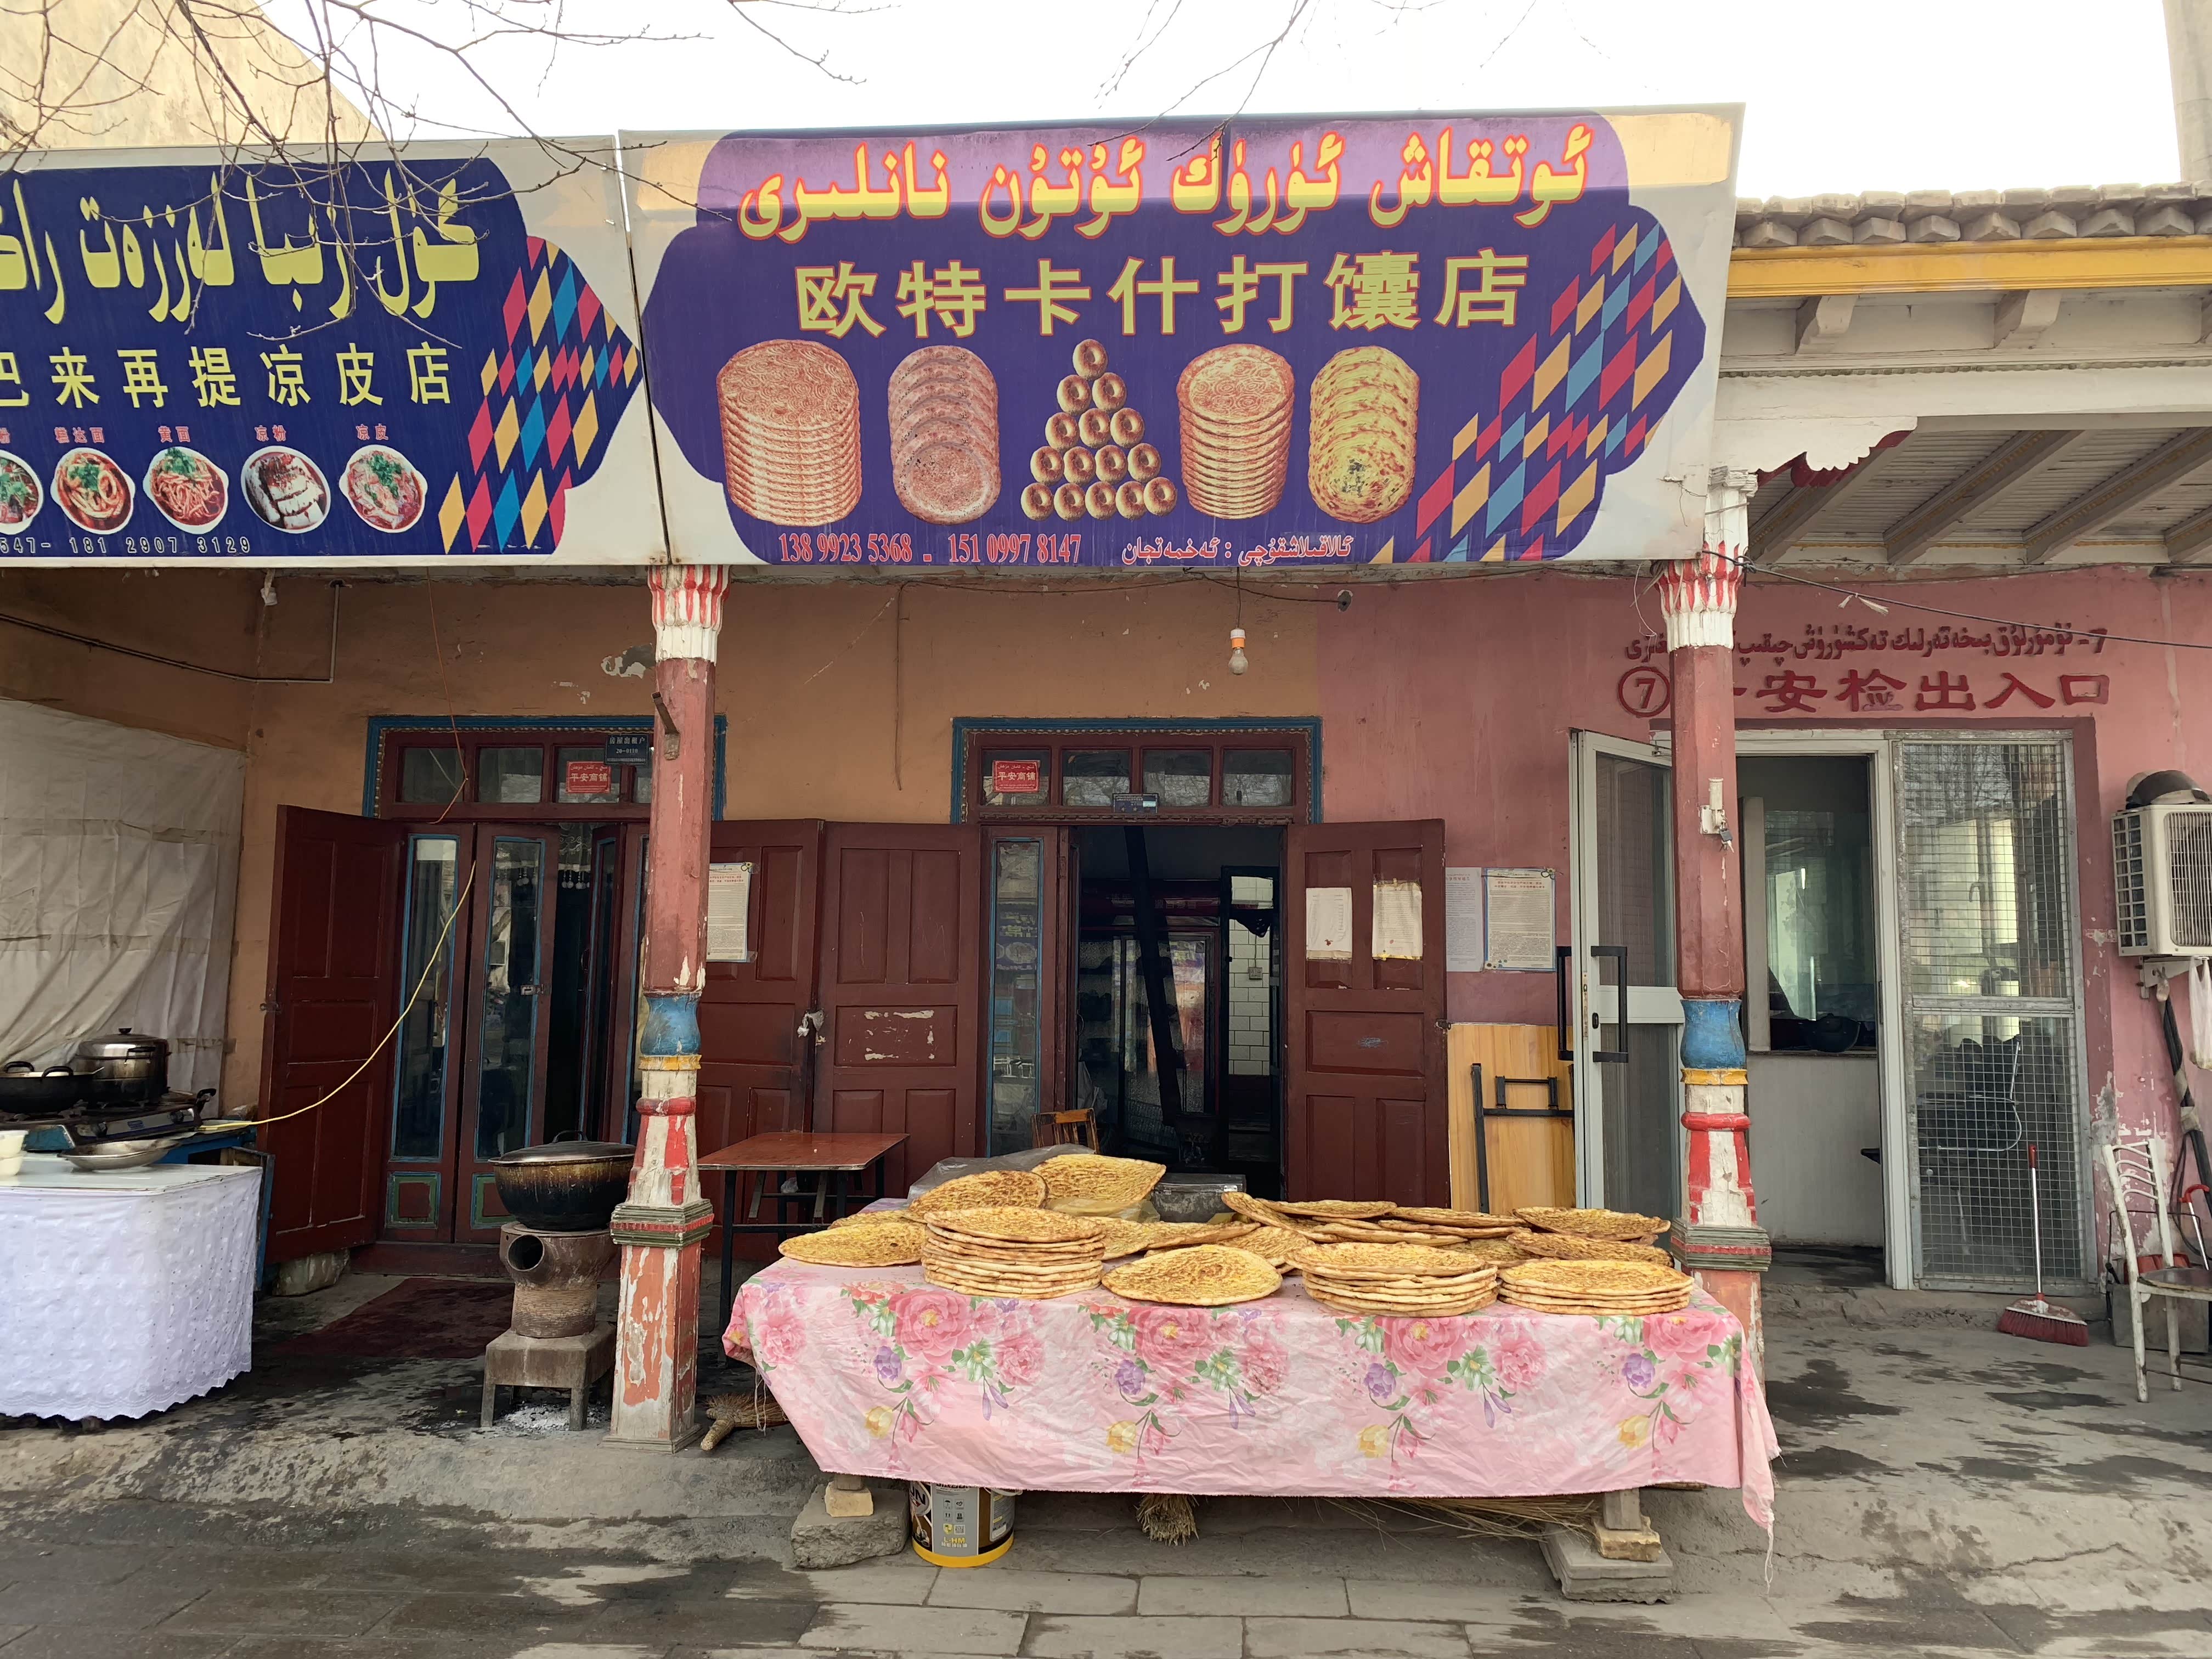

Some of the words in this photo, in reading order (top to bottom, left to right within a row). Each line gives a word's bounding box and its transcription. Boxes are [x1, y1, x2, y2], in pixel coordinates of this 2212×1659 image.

[794, 249, 1530, 338] 欧特卡什打馕店
[158, 426, 191, 443] 黄面
[255, 425, 286, 442] 凉粉
[356, 424, 389, 441] 凉皮
[69, 537, 108, 554] 181
[126, 537, 178, 554] 2907
[198, 536, 251, 554] 3129
[778, 533, 812, 562] 138
[817, 533, 861, 563] 9923
[867, 533, 912, 562] 5368
[948, 533, 980, 562] 151
[986, 533, 1031, 563] 0997
[1037, 533, 1081, 563] 8147
[569, 772, 608, 782] 平安商铺
[997, 771, 1036, 781] 平安商铺
